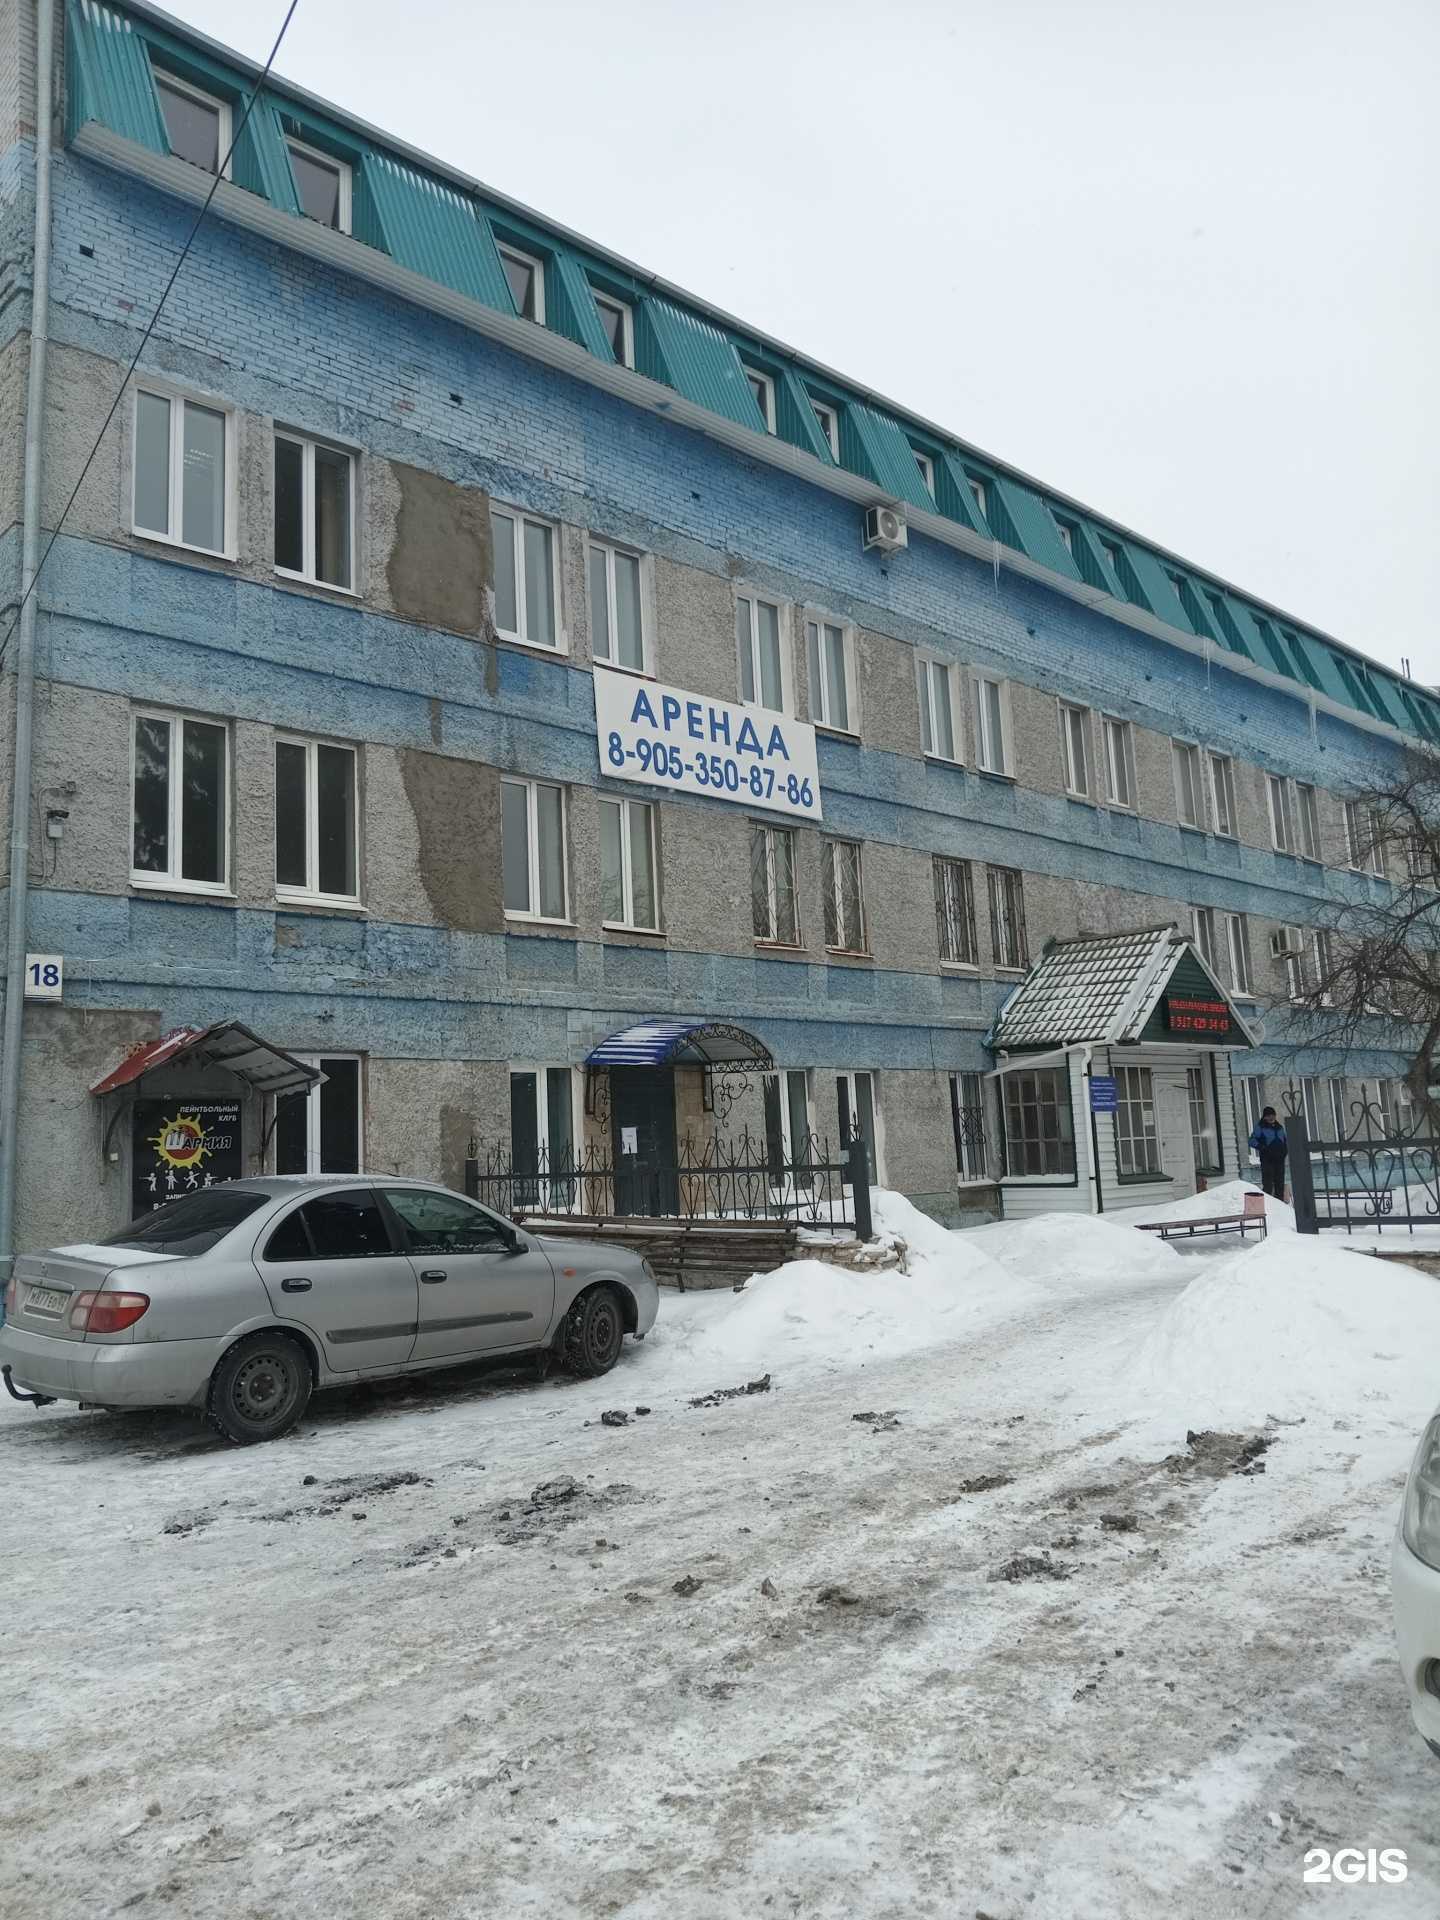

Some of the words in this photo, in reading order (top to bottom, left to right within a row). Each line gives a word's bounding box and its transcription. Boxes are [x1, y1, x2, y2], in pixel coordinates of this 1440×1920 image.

[630, 688, 790, 760] АРЕНДА
[608, 731, 813, 807] 8-905-350-87-86
[29, 963, 59, 987] 18
[180, 1104, 240, 1113] ПЕЙНТБОЛЬНЫЙ
[219, 1114, 237, 1122] КЛУБ
